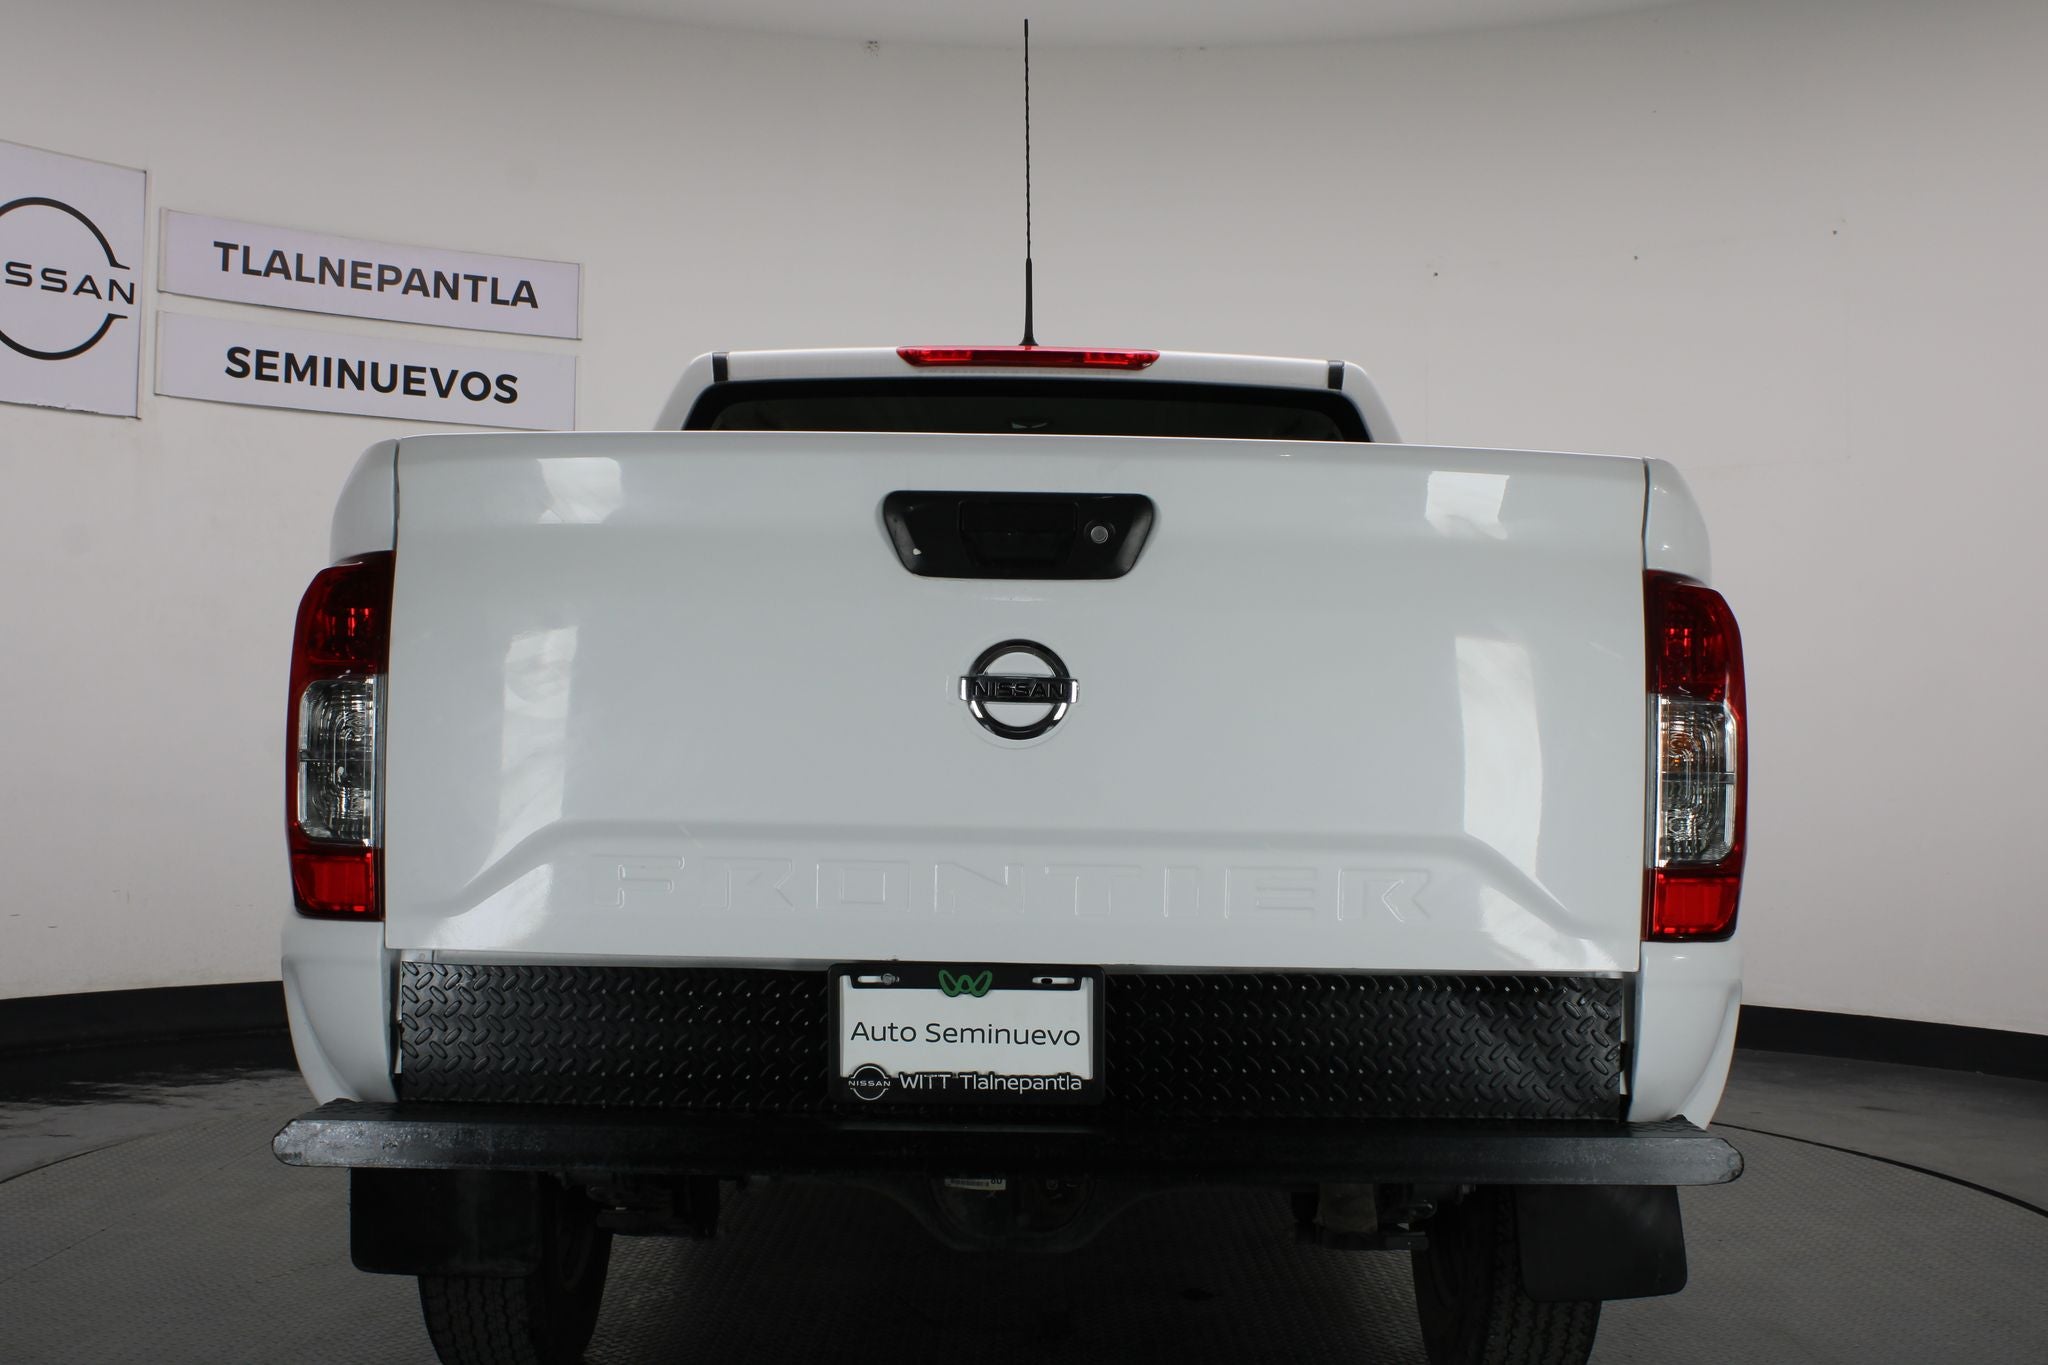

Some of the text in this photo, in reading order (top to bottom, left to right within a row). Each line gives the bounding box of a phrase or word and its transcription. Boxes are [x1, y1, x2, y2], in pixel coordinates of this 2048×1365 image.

[213, 241, 539, 309] TLALNEPANTLA
[225, 346, 519, 404] SEMINUEVOS
[974, 679, 1065, 698] NISSAN
[589, 854, 1432, 922] FRONTIER
[851, 1021, 1081, 1046] Auto Seminuevo
[900, 1074, 1083, 1094] WITT Tlalnepantla
